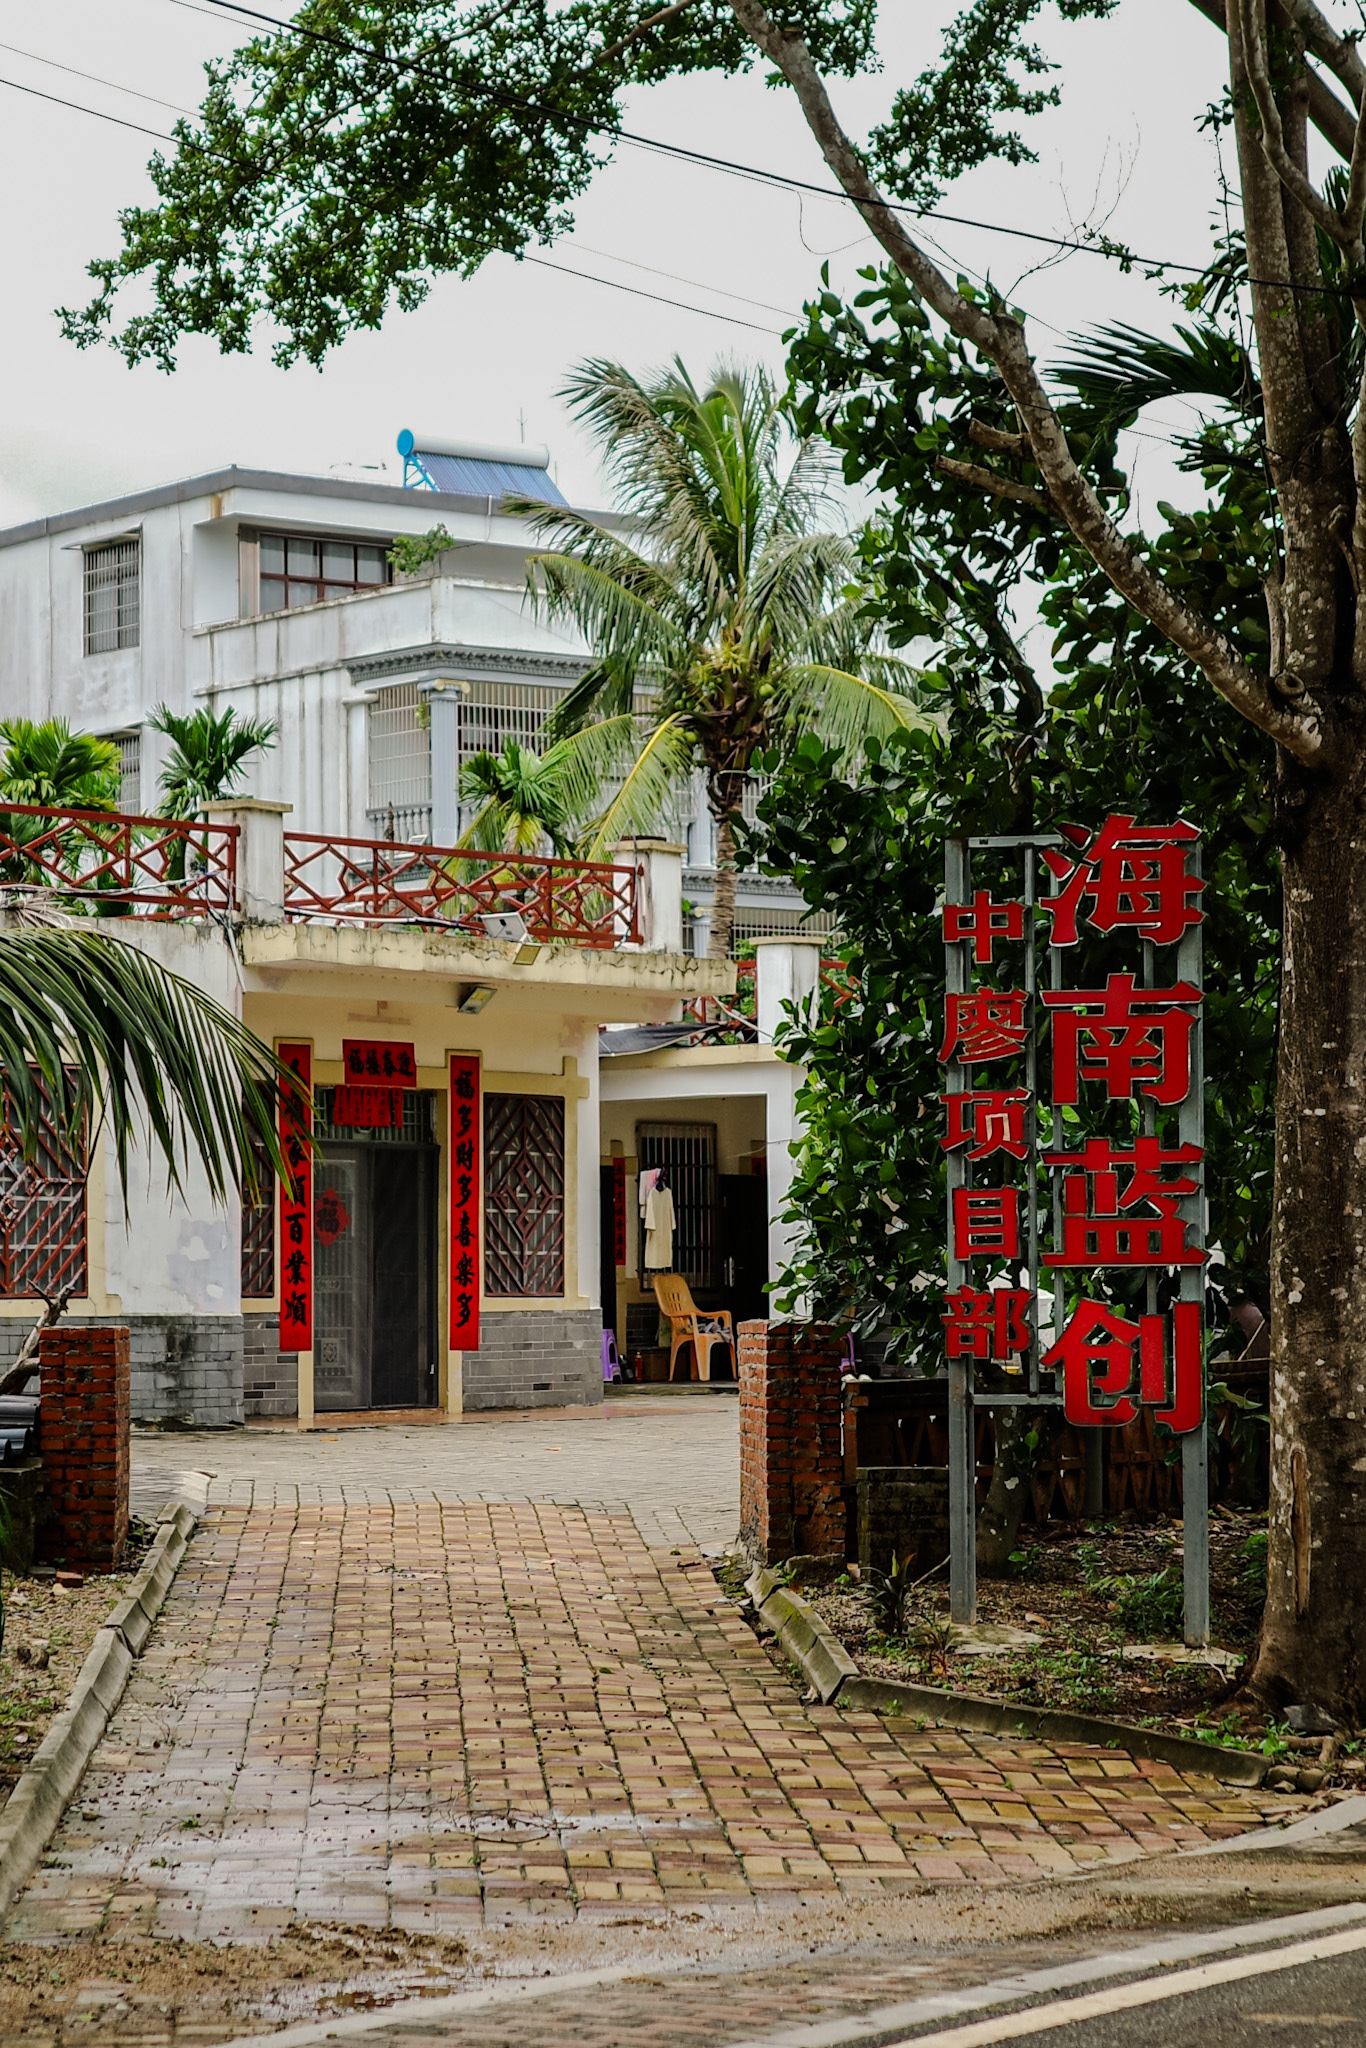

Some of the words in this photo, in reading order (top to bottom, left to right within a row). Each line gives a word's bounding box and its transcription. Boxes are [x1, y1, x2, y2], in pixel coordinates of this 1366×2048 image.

[316, 1197, 340, 1235] 福
[937, 889, 1033, 1360] 中廖项目部
[1038, 813, 1210, 1434] 海南蓝创
